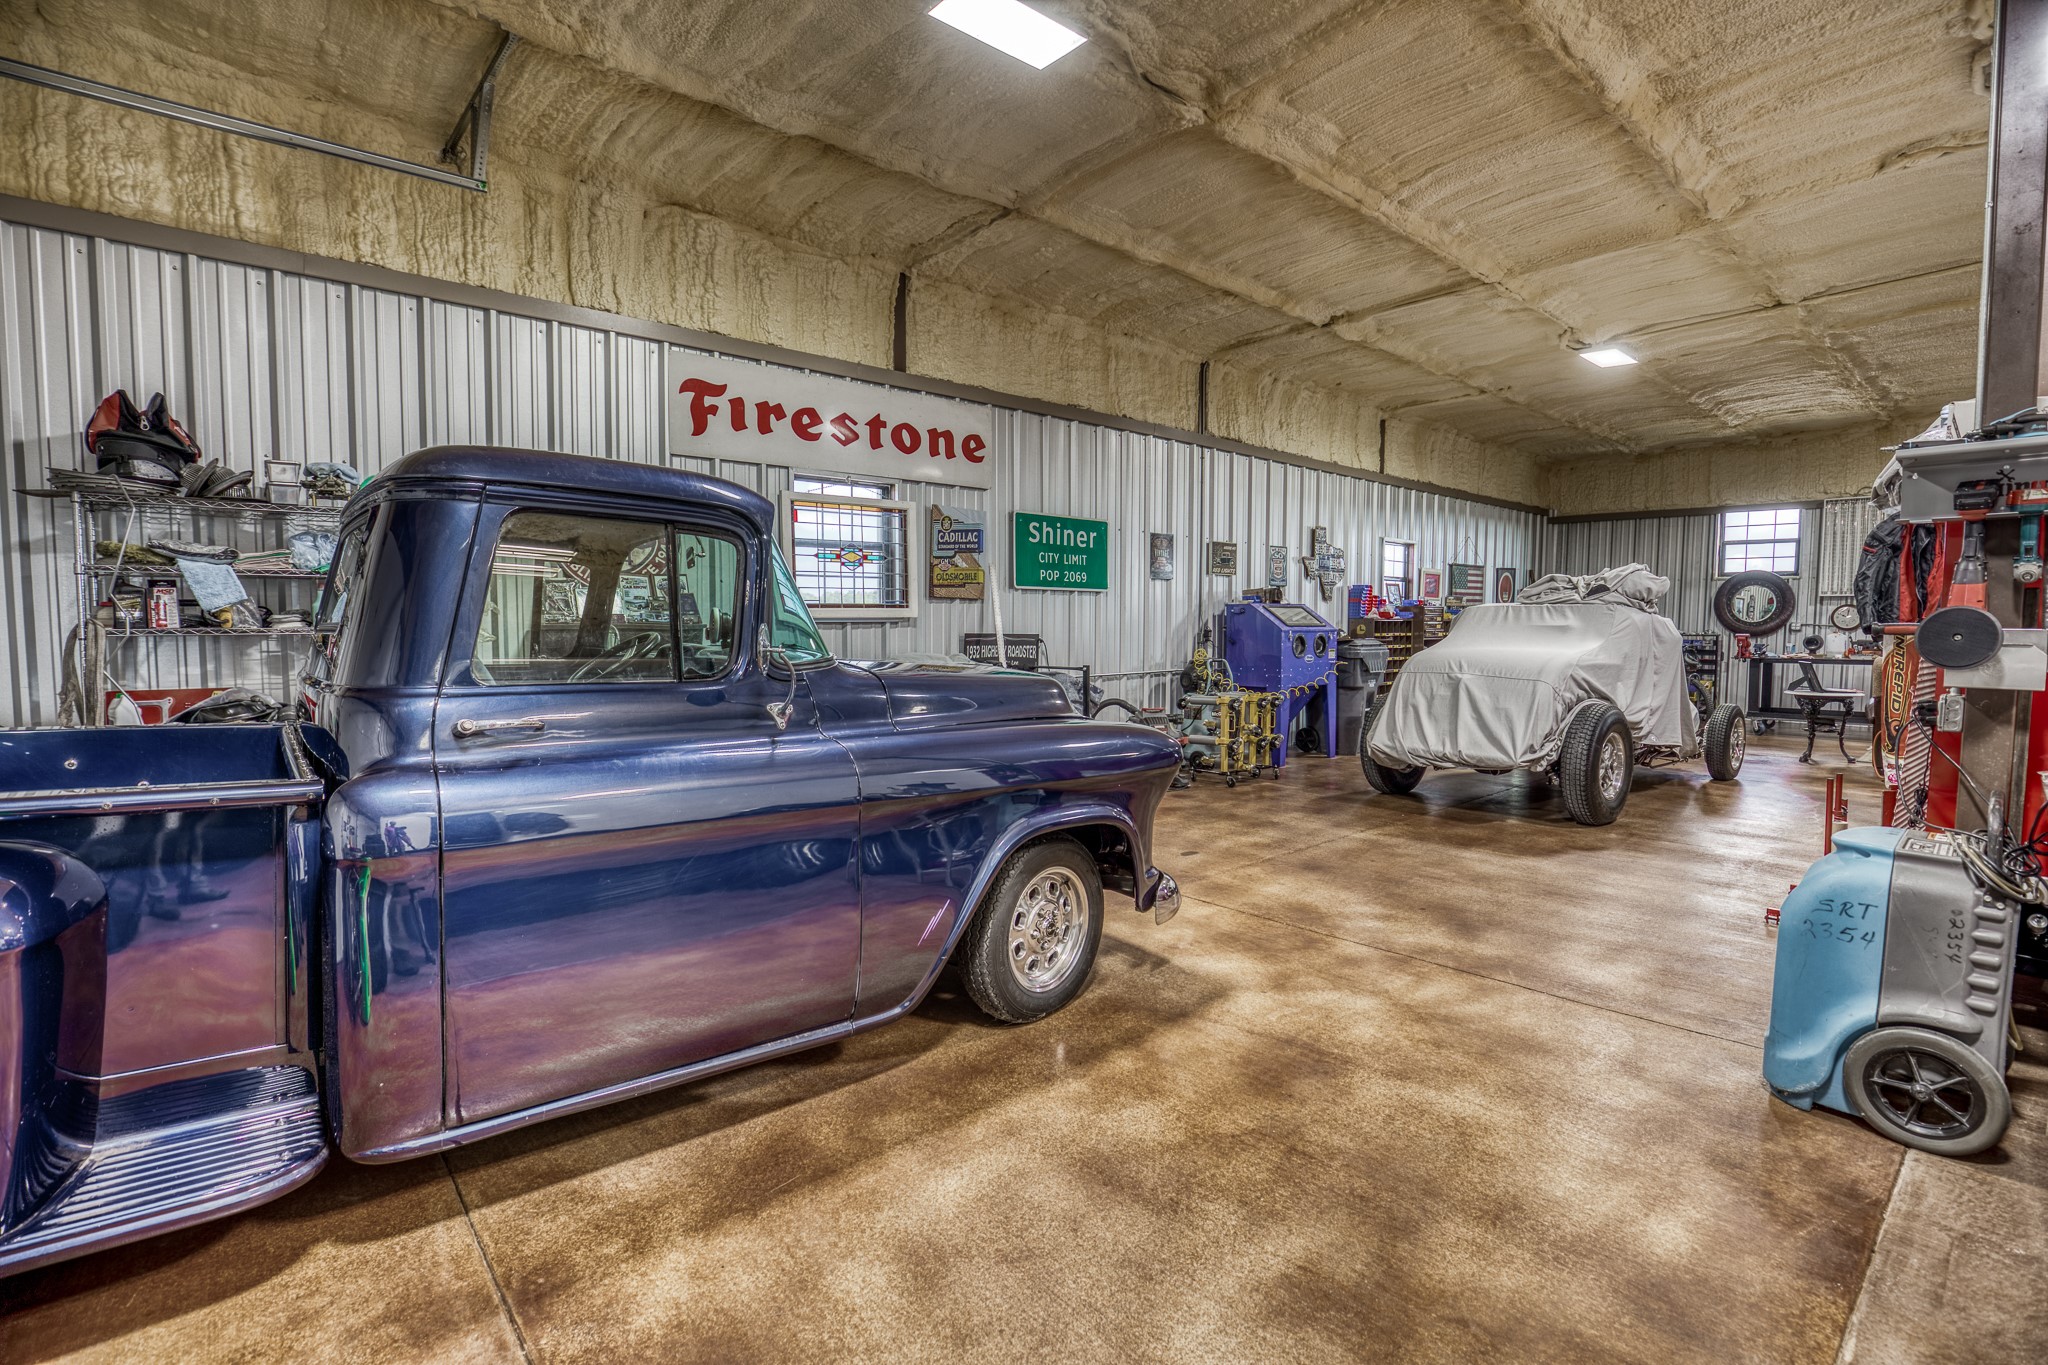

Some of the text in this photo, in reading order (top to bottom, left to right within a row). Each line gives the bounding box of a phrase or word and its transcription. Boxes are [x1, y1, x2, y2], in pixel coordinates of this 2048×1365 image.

[679, 378, 986, 463] Firestone
[938, 532, 979, 543] CADILLAC
[1029, 521, 1097, 548] Shiner
[1038, 551, 1087, 565] CITY LIMIT
[936, 571, 977, 581] OLDSMOBILE
[1040, 569, 1087, 582] POP 2069
[966, 645, 980, 659] 1932
[1008, 645, 1037, 658] ROADSTER
[1891, 634, 1906, 714] NTREPID
[1811, 899, 1878, 920] SRT
[1802, 919, 1876, 950] 2354
